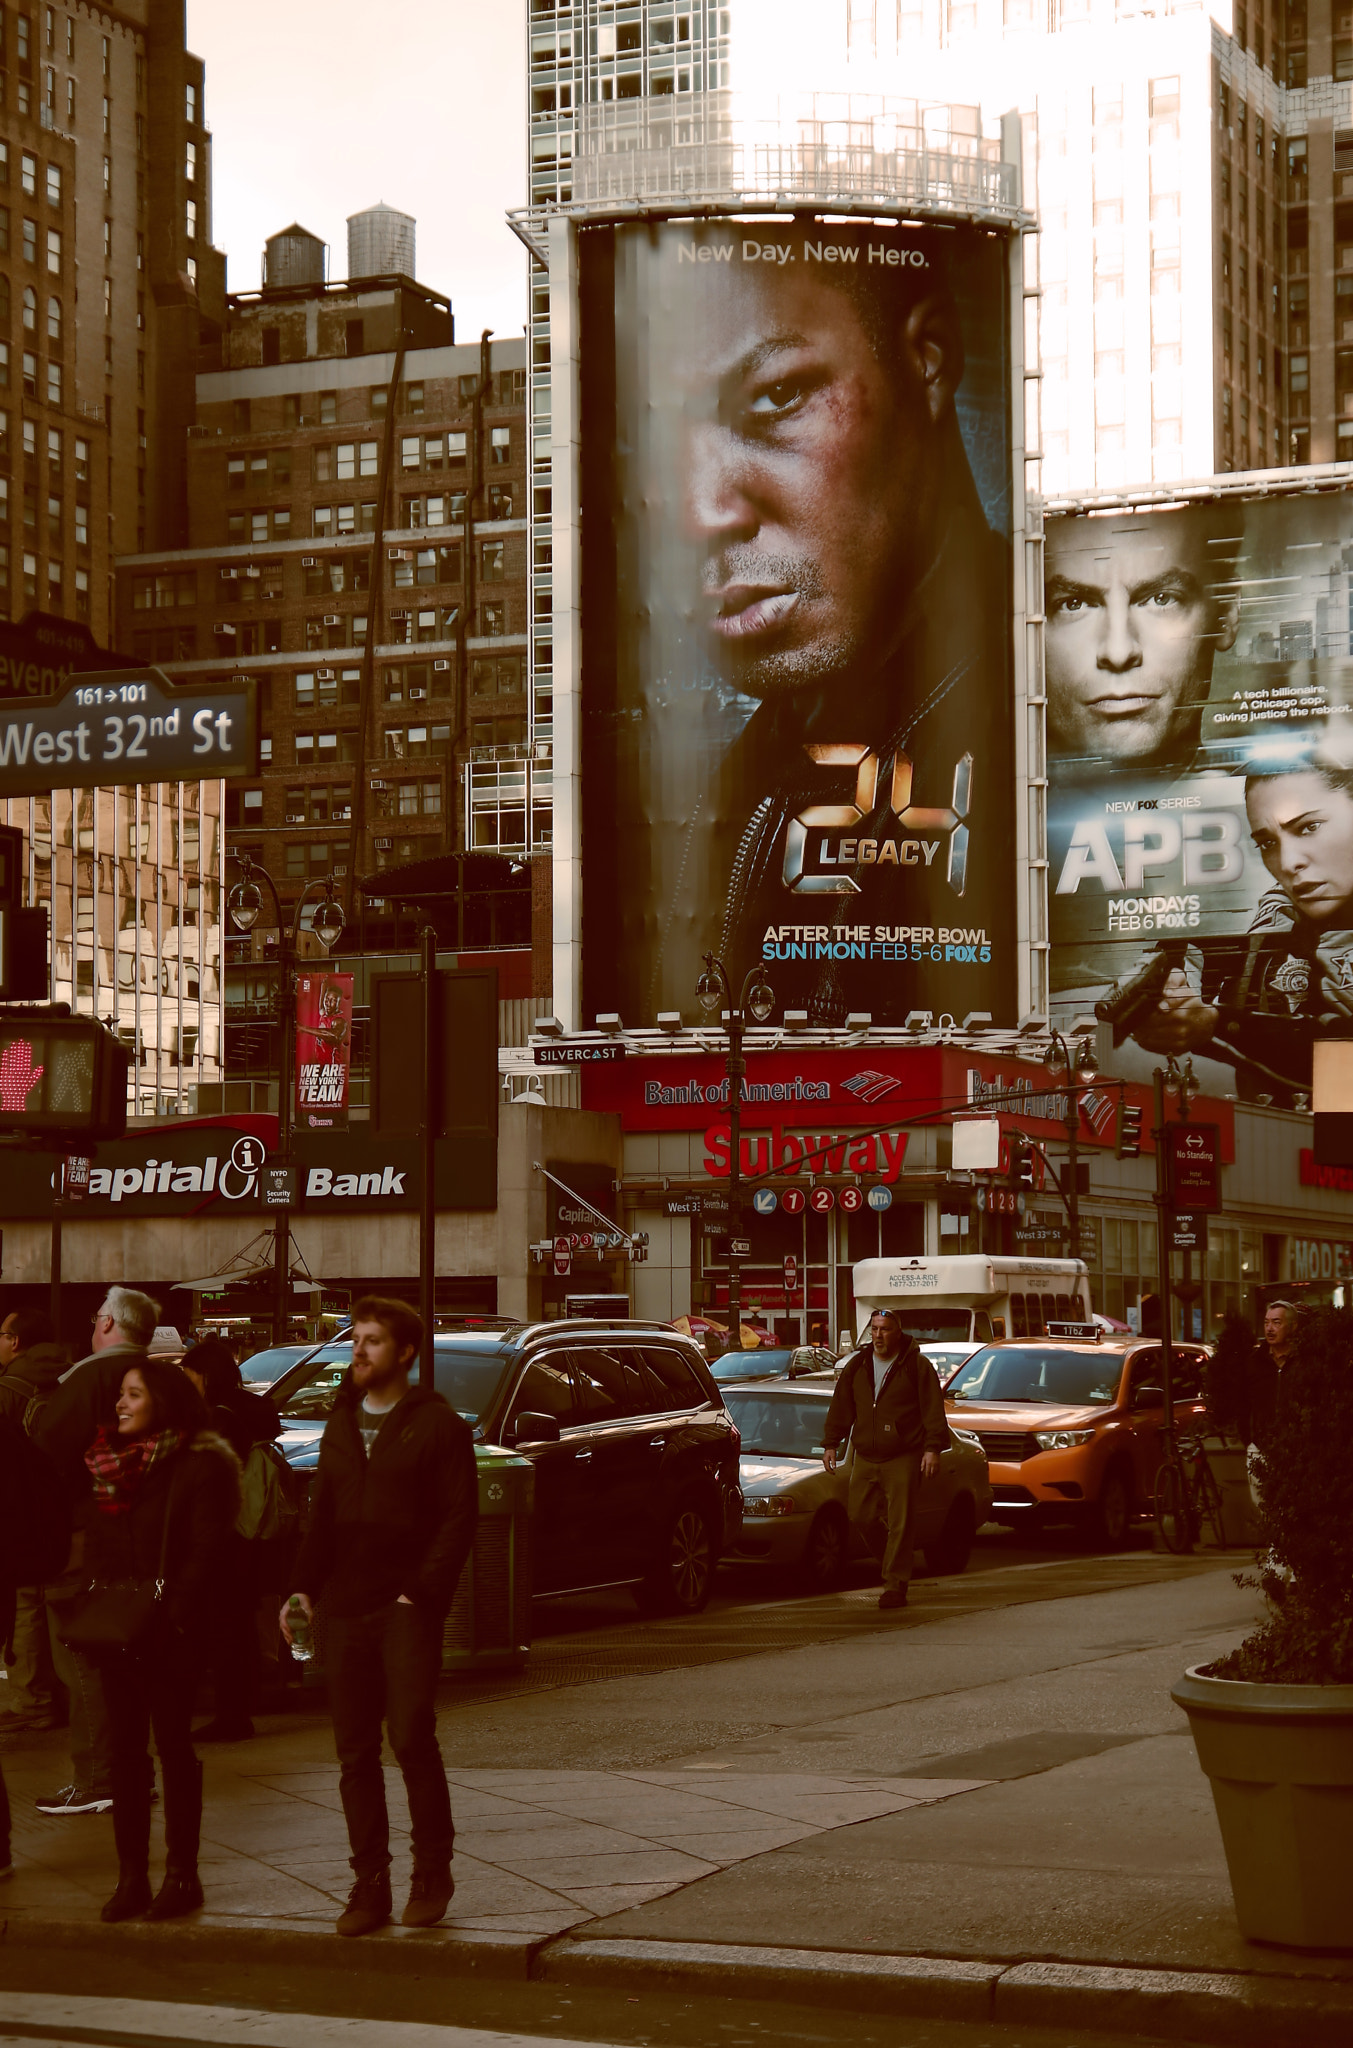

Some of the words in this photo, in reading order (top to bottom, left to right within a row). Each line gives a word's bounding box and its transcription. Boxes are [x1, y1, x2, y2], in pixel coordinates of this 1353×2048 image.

[678, 242, 734, 263] New
[742, 240, 795, 265] Day.
[804, 240, 859, 263] New
[868, 243, 930, 267] Hero.
[0, 653, 74, 697] event
[75, 687, 103, 706] 161
[119, 684, 147, 703] 101
[1232, 691, 1242, 700] A
[1244, 689, 1269, 699] tech
[1272, 684, 1328, 697] billionaire.
[1239, 701, 1249, 710] A
[1251, 698, 1298, 709] Chicago
[1300, 696, 1325, 706] cop.
[1213, 712, 1248, 723] Giving
[1249, 709, 1288, 721] justice
[1289, 707, 1309, 717] the
[1311, 704, 1353, 715] reboot.
[0, 722, 91, 766] West
[103, 708, 180, 760] 32nd
[192, 709, 232, 753] St
[1105, 801, 1136, 813] NEW
[1138, 799, 1158, 810] FOX
[1160, 796, 1201, 809] SERIES
[782, 743, 974, 897] 24
[819, 838, 940, 866] LEGACY
[1055, 812, 1245, 895] APB
[1108, 894, 1200, 916] MONDAYS
[1108, 915, 1140, 931] FEB
[1143, 914, 1154, 929] 6
[1156, 913, 1187, 929] FOX
[1189, 912, 1200, 927] 5
[763, 925, 829, 942] AFTER
[832, 925, 870, 942] THE
[874, 926, 935, 943] SUPER
[938, 928, 991, 945] BOWL
[870, 943, 907, 961] FEB
[910, 944, 942, 962] 5-6
[945, 945, 978, 962] FOX
[980, 946, 992, 963] 5
[540, 1048, 616, 1061] SILVERCAST
[301, 1064, 320, 1077] WE
[321, 1064, 346, 1077] ARE
[299, 1077, 318, 1085] NEW
[319, 1077, 345, 1085] YORK'S
[299, 1085, 344, 1102] TEAM
[644, 1080, 703, 1105] Bank
[705, 1078, 731, 1101] of
[738, 1076, 830, 1102] America
[967, 1069, 1008, 1112] Bank
[1008, 1077, 1023, 1115] of
[1024, 1079, 1072, 1121] Americ
[703, 1123, 909, 1184] Subway
[1176, 1150, 1186, 1159] No
[1187, 1150, 1214, 1162] Standing
[67, 1170, 89, 1183] TEAM
[305, 1166, 407, 1197] Bank
[1200, 1178, 1211, 1186] Zone
[266, 1190, 291, 1198] Security
[788, 1193, 798, 1209] 1
[816, 1191, 829, 1208] 2
[844, 1190, 857, 1208] 3
[870, 1190, 888, 1206] MTA
[999, 1192, 1006, 1209] 2
[1008, 1193, 1015, 1210] 3
[668, 1202, 690, 1212] West
[703, 1199, 720, 1209] Seventh
[721, 1200, 729, 1210] Ave
[583, 1235, 589, 1245] 3
[1016, 1231, 1035, 1240] West
[1036, 1230, 1051, 1239] 33rd
[1052, 1231, 1061, 1239] St
[1063, 1326, 1083, 1336] 1T62
